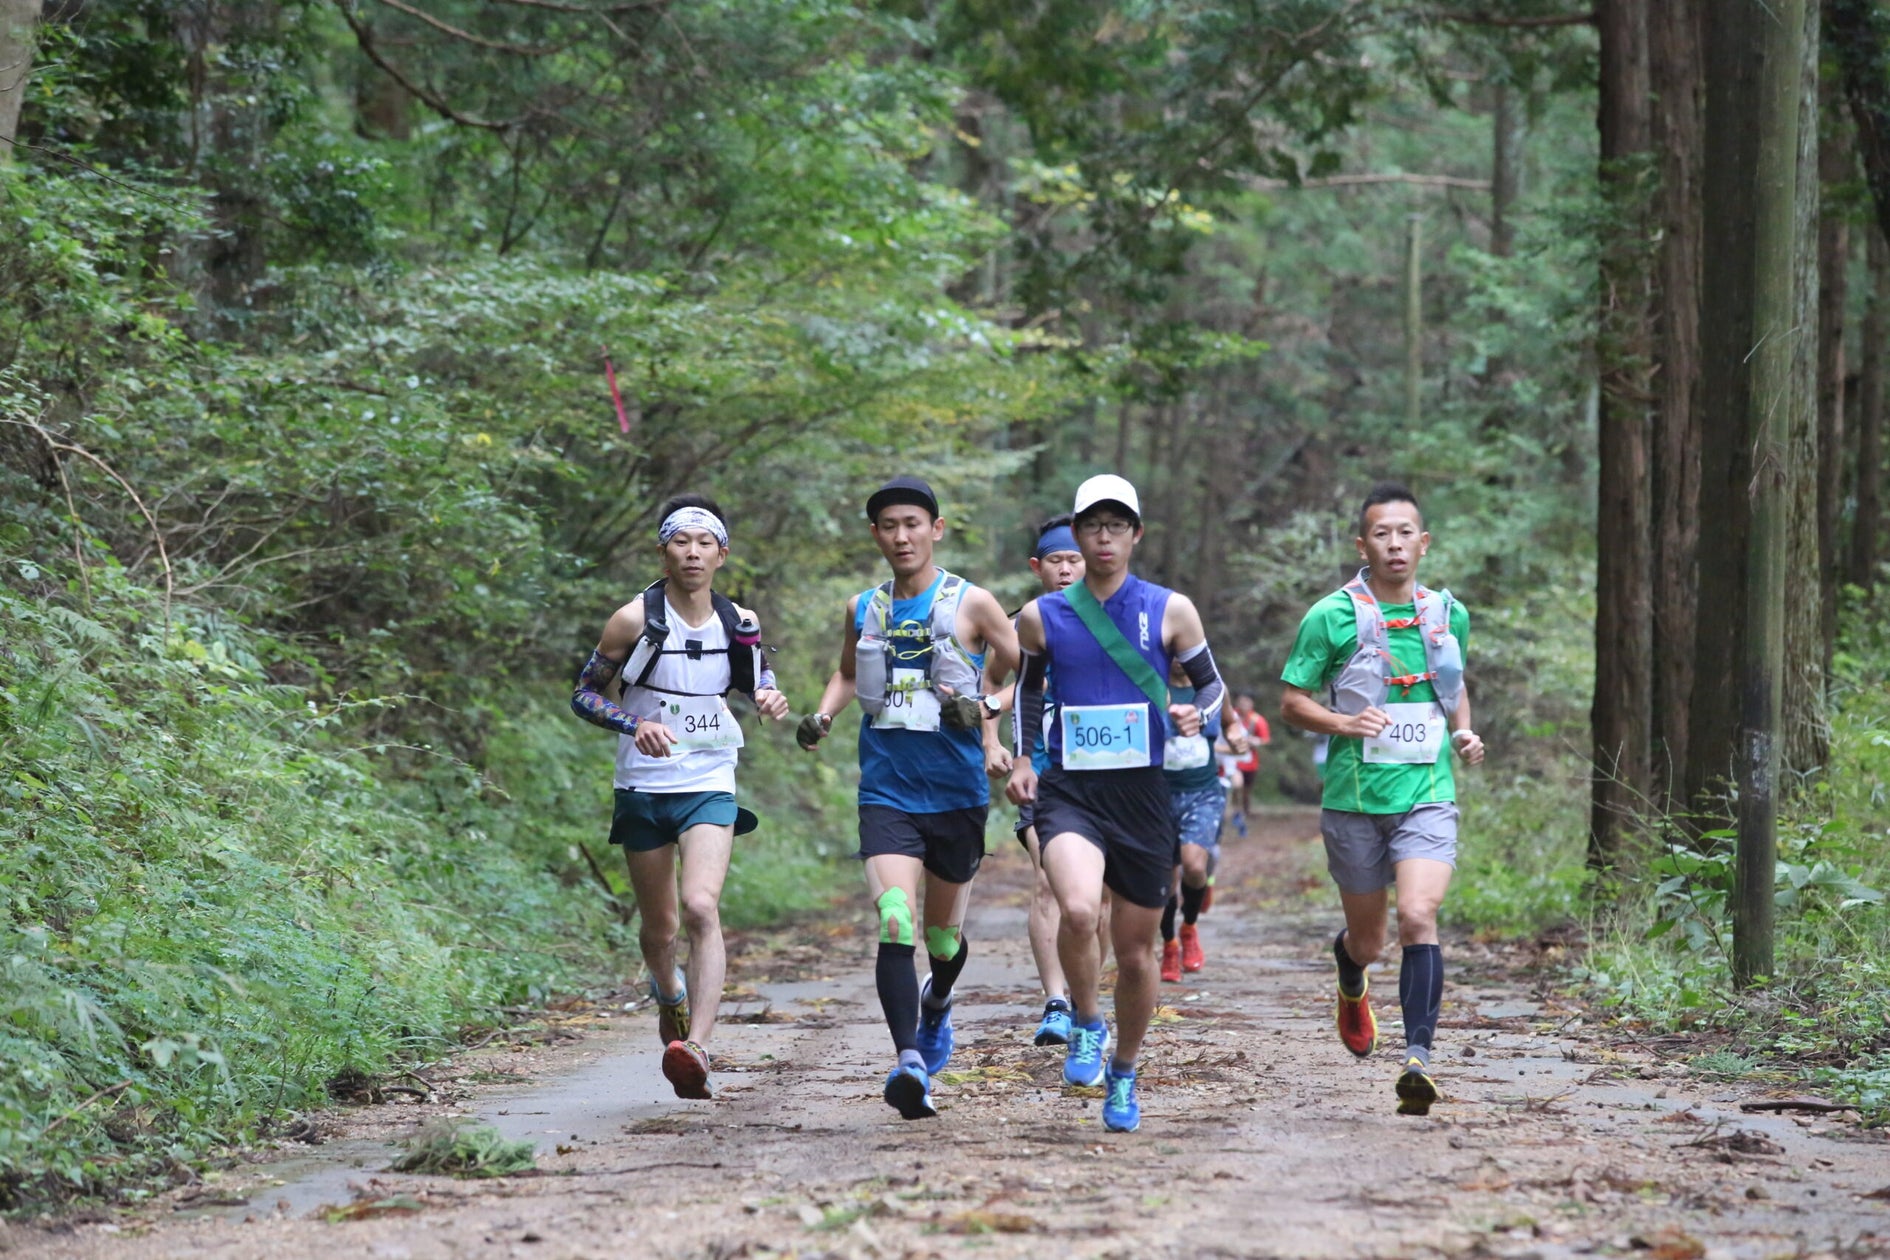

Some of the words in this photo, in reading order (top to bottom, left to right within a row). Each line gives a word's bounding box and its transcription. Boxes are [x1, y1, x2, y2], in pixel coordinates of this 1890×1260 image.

[685, 713, 721, 733] 344
[1389, 723, 1426, 743] 403
[1075, 725, 1132, 747] 506-1
